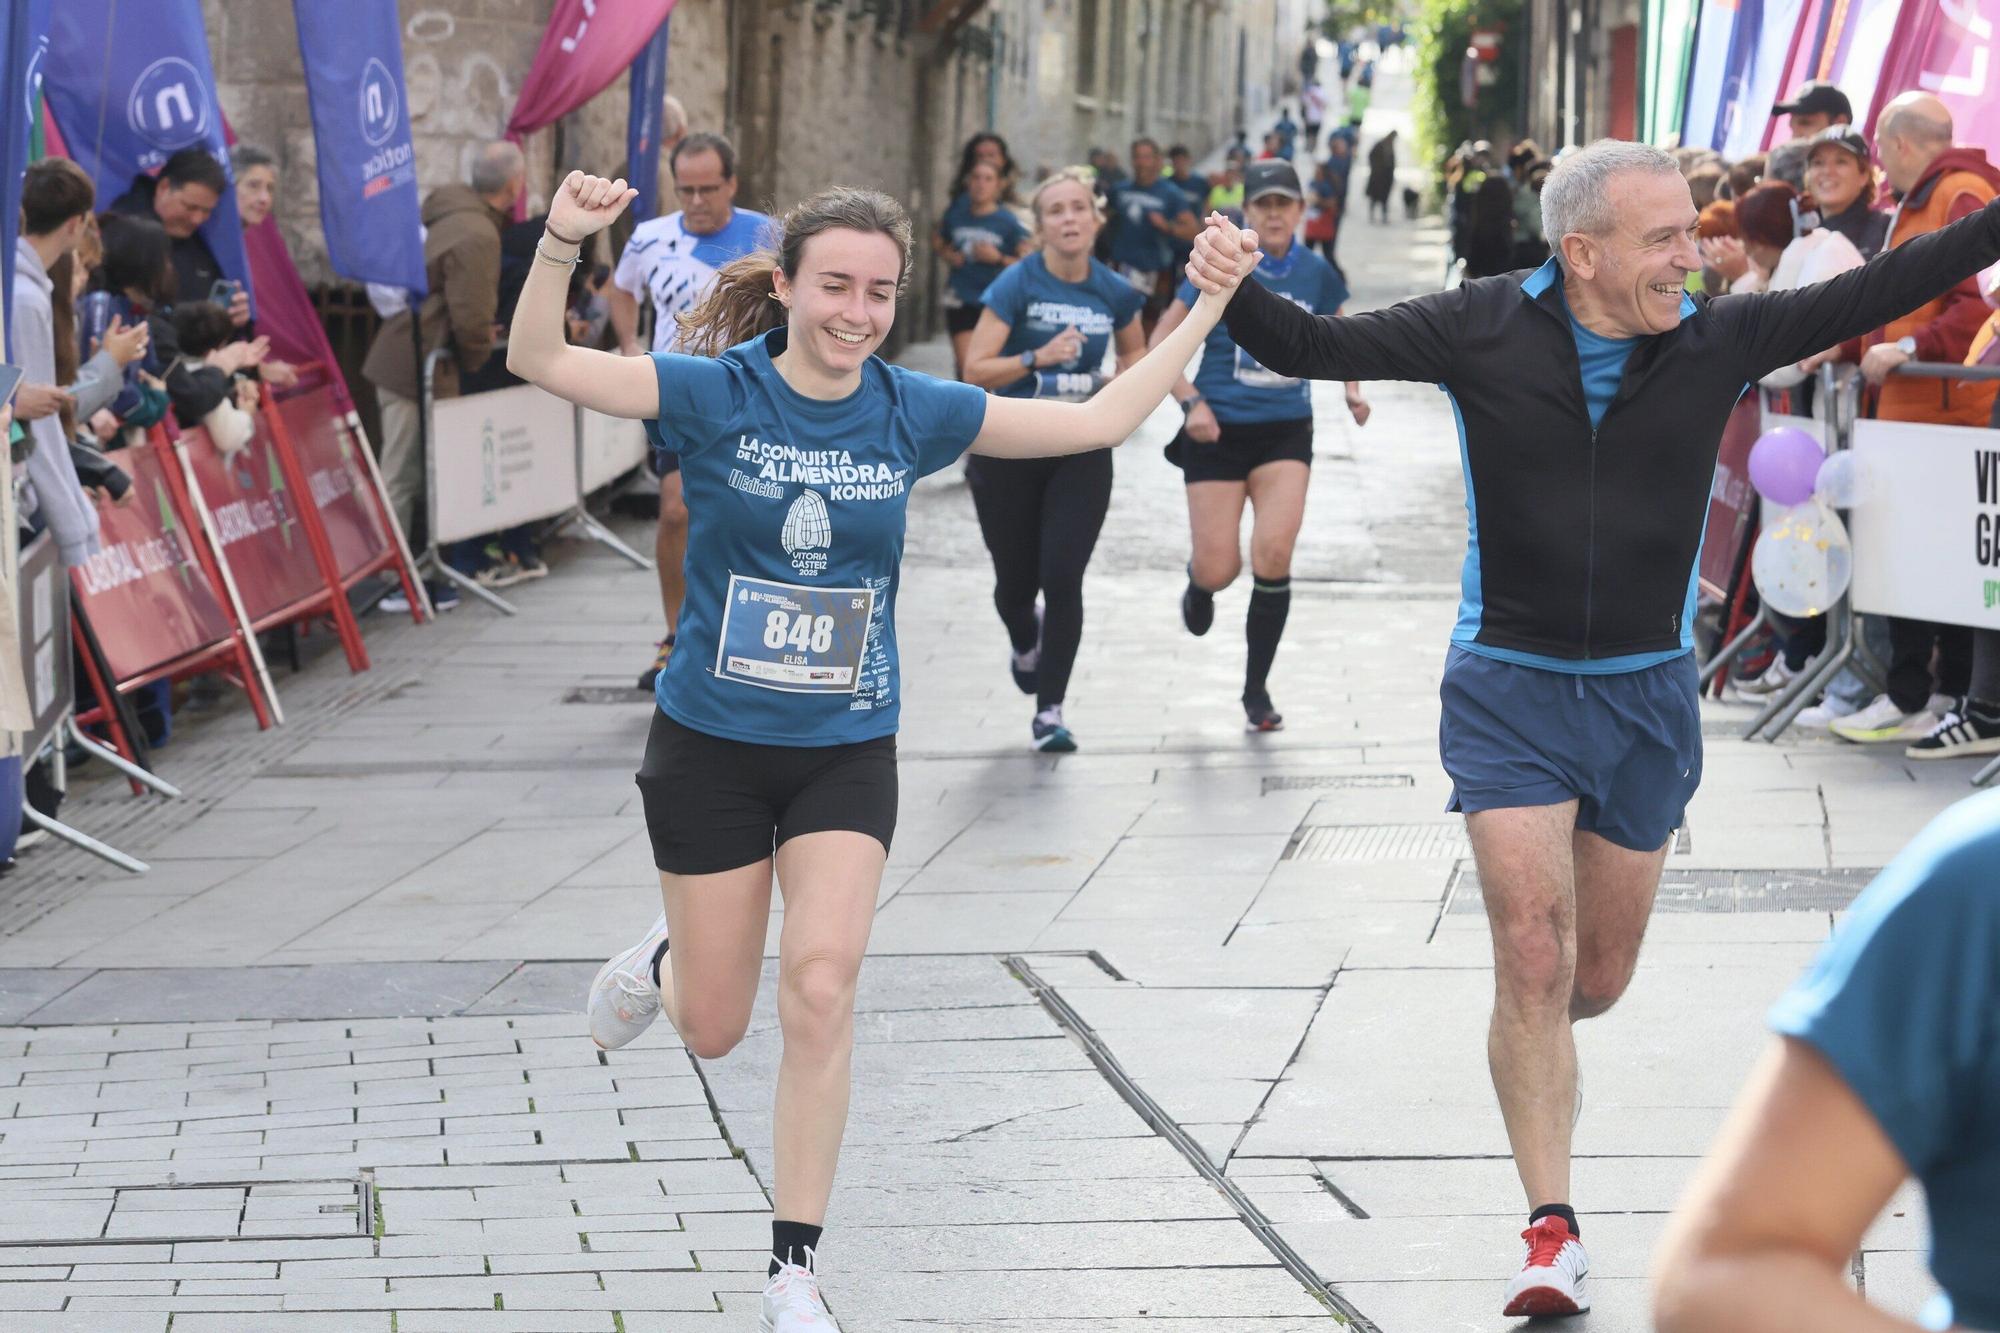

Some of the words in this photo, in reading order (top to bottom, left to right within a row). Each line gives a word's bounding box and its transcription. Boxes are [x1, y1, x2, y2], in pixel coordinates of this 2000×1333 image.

[739, 435, 759, 453] LA
[761, 443, 852, 466] CONQUISTA
[736, 450, 750, 461] DE
[752, 454, 765, 466] LA
[759, 459, 893, 485] ALMENDRA
[1974, 450, 2000, 505] VI
[739, 476, 784, 499] Edición
[830, 481, 905, 501] KONKISTA
[791, 560, 828, 570] GASTEIZ
[792, 551, 828, 561] VITORIA
[798, 569, 818, 577] 2025
[851, 599, 865, 609] 5K
[763, 610, 835, 654] 848
[783, 655, 808, 665] ELISA
